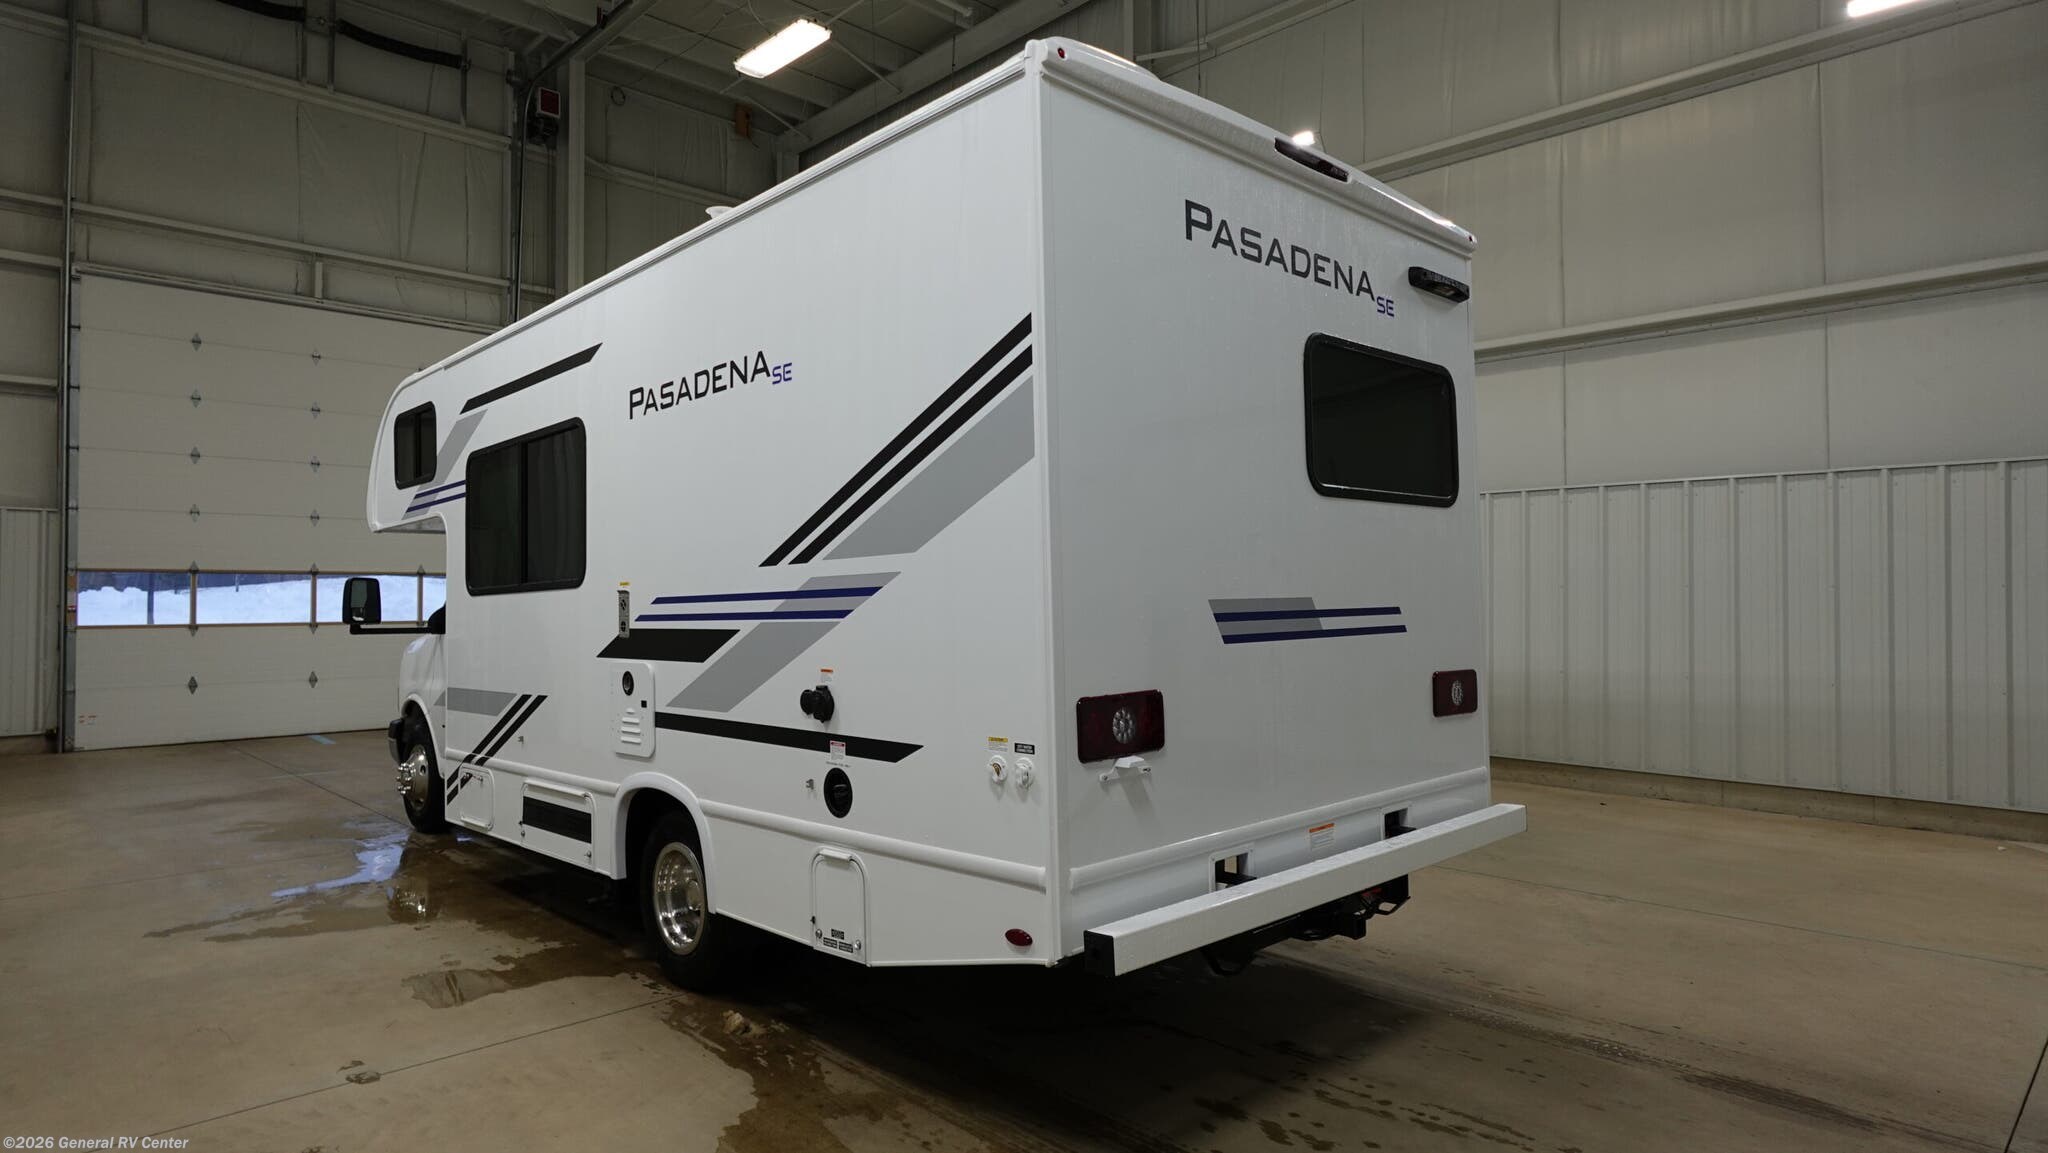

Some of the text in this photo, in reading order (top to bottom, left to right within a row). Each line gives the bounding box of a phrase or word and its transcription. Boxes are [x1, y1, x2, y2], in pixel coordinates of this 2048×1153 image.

[1185, 199, 1395, 317] PASADENA SE
[629, 350, 793, 420] PASADENA SE
